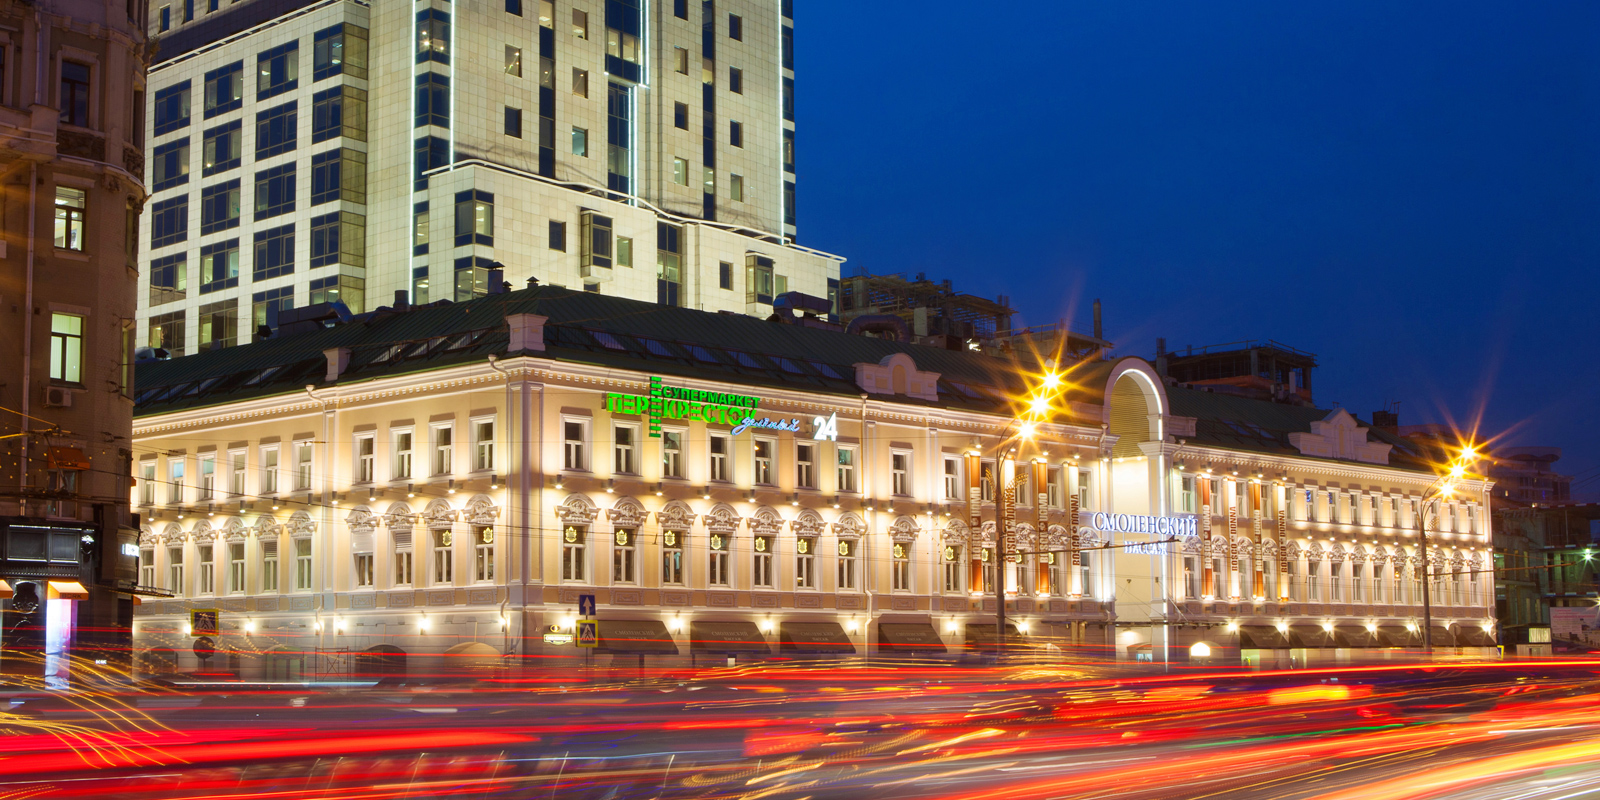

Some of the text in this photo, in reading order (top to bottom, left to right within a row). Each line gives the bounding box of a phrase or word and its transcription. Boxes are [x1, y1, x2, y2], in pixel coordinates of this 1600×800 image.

[662, 385, 761, 409] СУПЕРМАРКЕТ
[813, 411, 838, 442] 24
[1070, 494, 1081, 566] BOSCO DONNA
[1092, 512, 1199, 536] СМОЛЕНСКИЙ
[1228, 506, 1238, 535] DONNA
[1278, 511, 1286, 537] DONNA
[1124, 540, 1168, 555] ПАССАЖ
